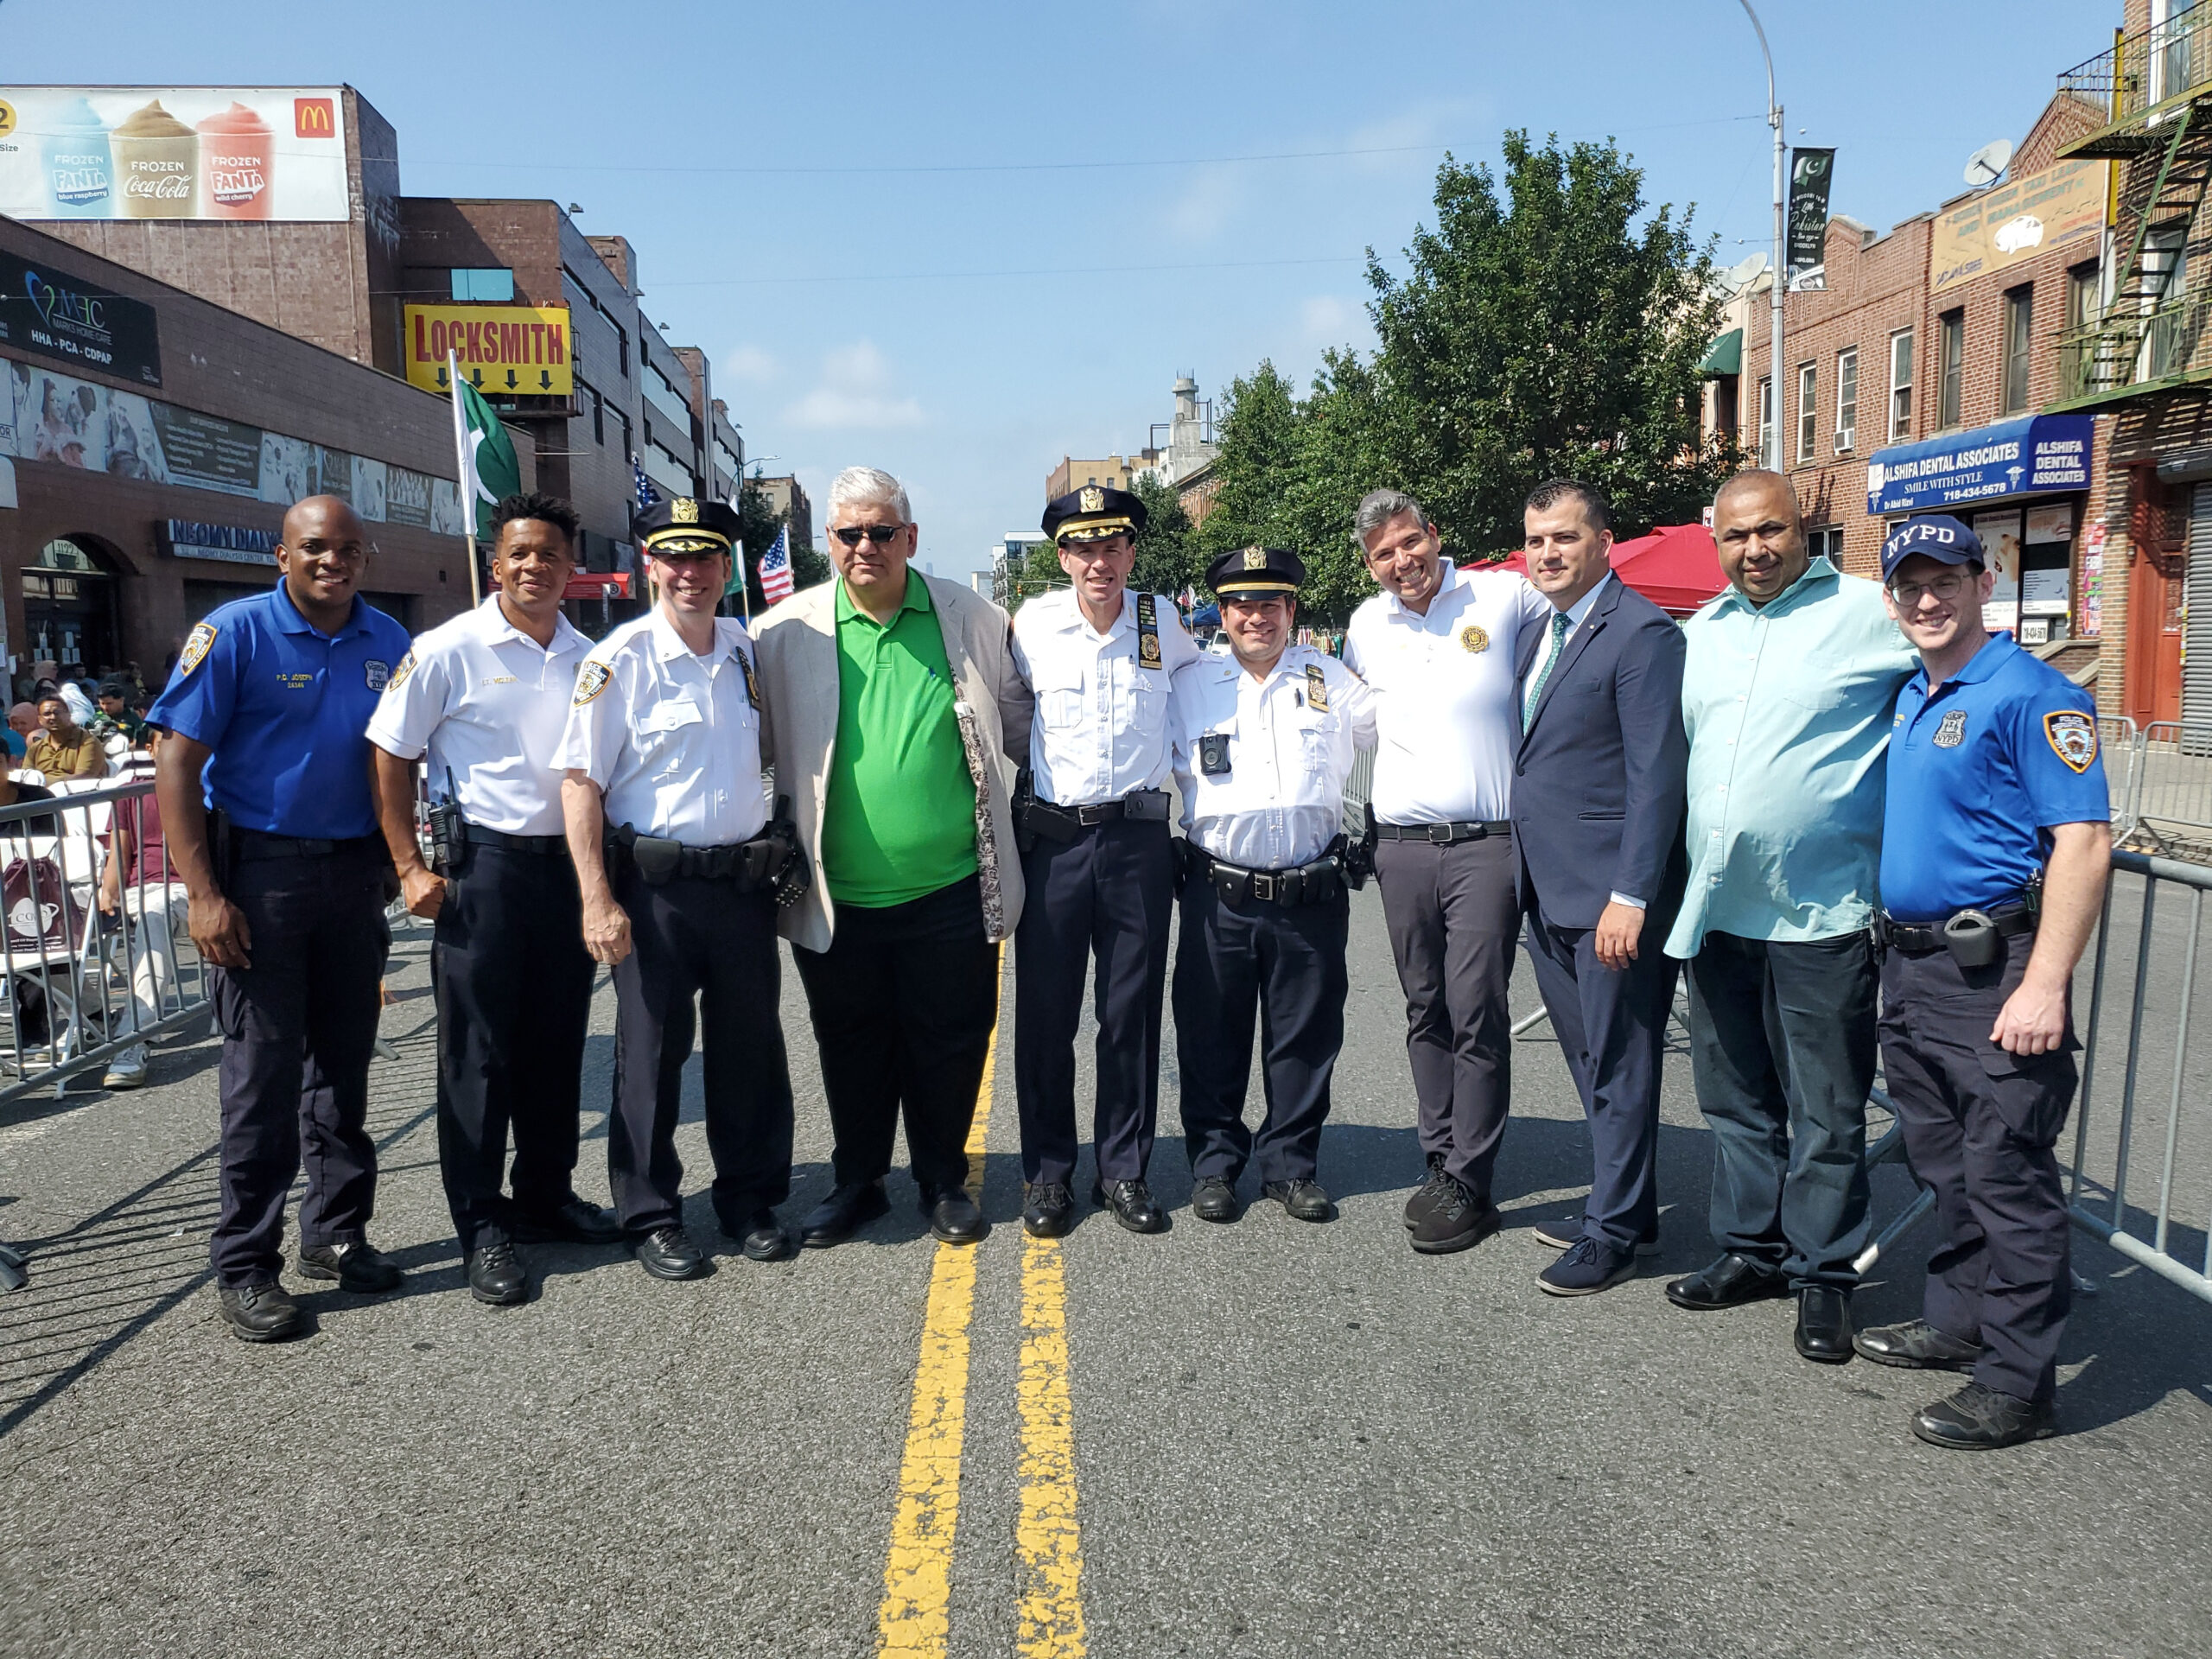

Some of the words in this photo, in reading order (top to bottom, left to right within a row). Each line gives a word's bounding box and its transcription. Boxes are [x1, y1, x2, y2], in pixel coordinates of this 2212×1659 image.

[54, 156, 105, 165] FROZEN
[131, 161, 184, 172] FROZEN
[213, 156, 261, 167] FROZEN
[54, 168, 108, 191] FANTA
[124, 175, 193, 199] Coca-Cola
[211, 169, 264, 191] FANTA
[58, 192, 73, 200] blue
[74, 190, 107, 200] raspberry
[231, 192, 253, 202] cherry
[1789, 212, 1825, 233] Pakistan
[31, 329, 53, 346] HHA
[60, 338, 79, 355] PCA
[85, 346, 112, 365] CDPAP
[415, 315, 563, 365] LOCKSMITH
[2035, 441, 2083, 454] ALSHIFA
[1884, 461, 1919, 483] ALSHIFA
[1919, 454, 1955, 477] DENTAL
[1956, 442, 2019, 469] ASSOCIATES
[2036, 455, 2082, 470] DENTAL
[1904, 479, 1929, 494] SMILE
[1929, 476, 1955, 490] WITH
[1955, 471, 1983, 487] STYLE
[2032, 470, 2086, 485] ASSOCIATES
[1944, 482, 2006, 501] 718-434-5678
[1887, 524, 1955, 559] NYPD
[219, 550, 244, 560] DIALYSIS
